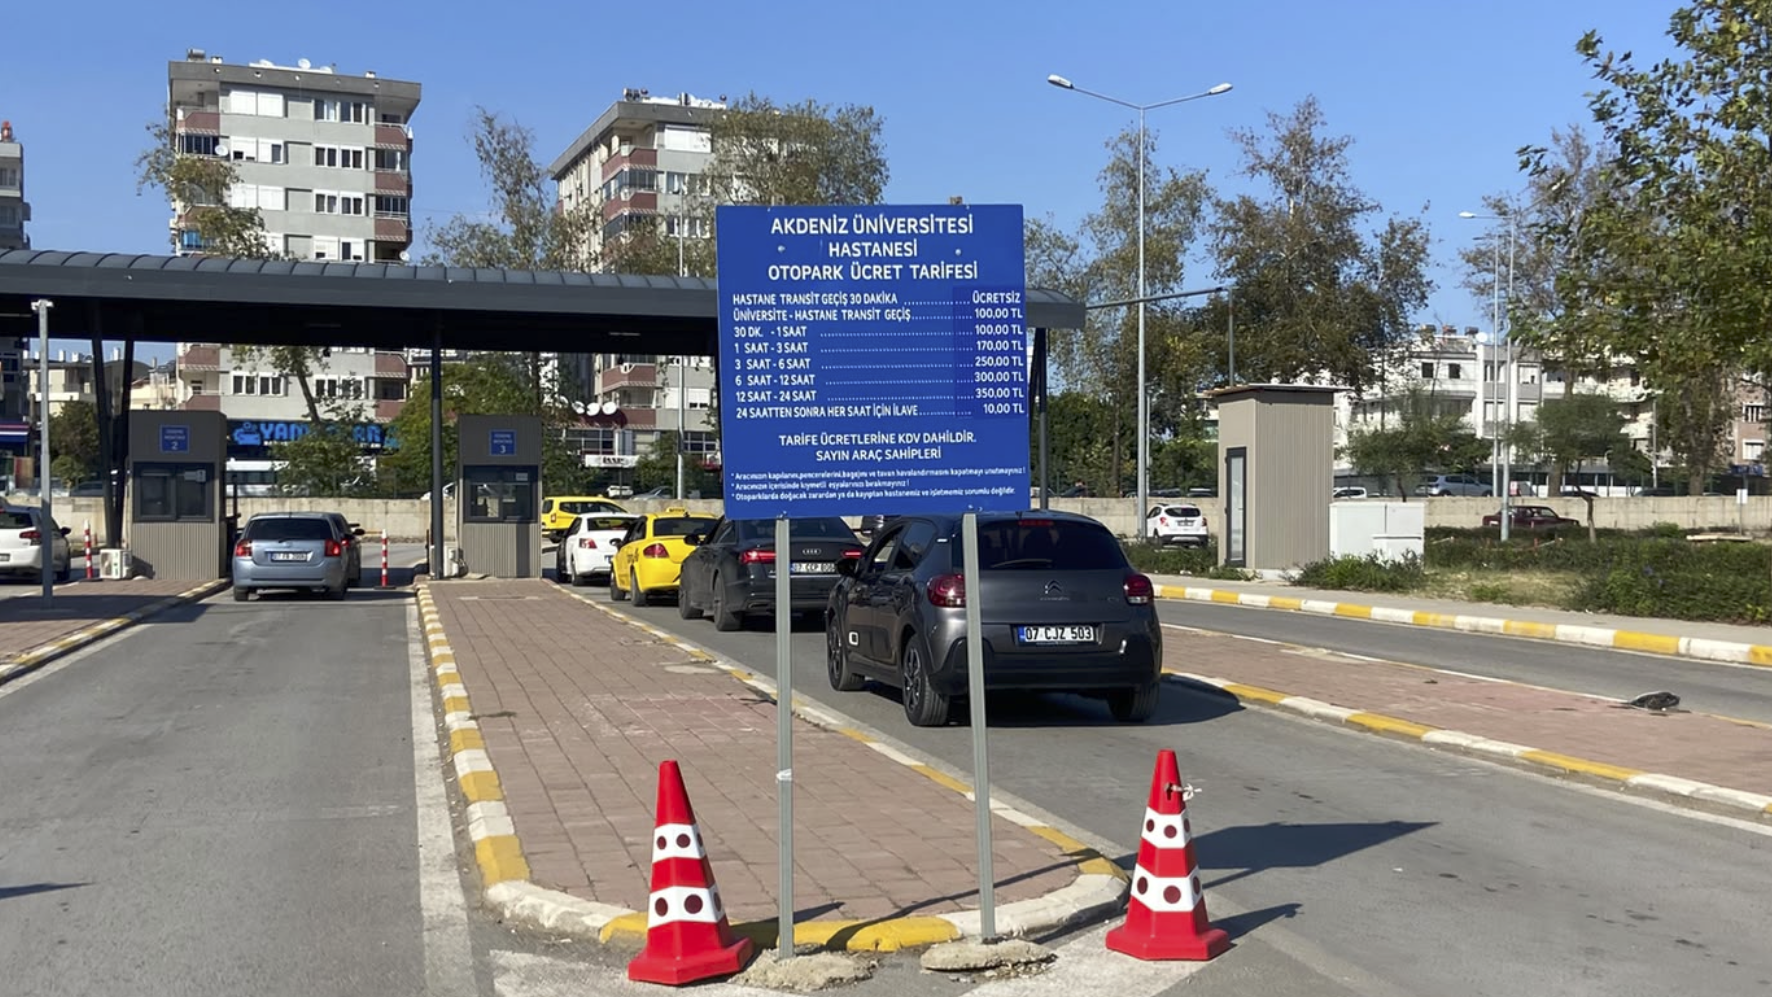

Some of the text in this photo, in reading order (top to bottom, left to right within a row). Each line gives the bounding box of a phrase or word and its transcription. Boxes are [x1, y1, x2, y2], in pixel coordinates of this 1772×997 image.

[771, 214, 973, 234] AKDENİZ ÜNİVERSİTESİ
[829, 238, 917, 257] HASTANESİ
[768, 261, 977, 280] OTOPARK ÜCRET TARİFESİ
[733, 290, 1020, 306] HASTANE TRANSİT GEÇİŞ 30 DAKİKA ÜCRETSİZ
[734, 308, 787, 321] ÜNİVERSİTE
[795, 310, 837, 320] HASTANE
[841, 307, 881, 320] TRANSİT
[884, 307, 911, 322] GEÇİŞ
[975, 308, 1008, 319] 100,00
[1011, 308, 1022, 318] TL
[734, 326, 746, 337] 30
[783, 326, 807, 337] SAAT
[975, 324, 1009, 335] 100,00
[1011, 324, 1023, 334] TL
[744, 342, 769, 353] SAAT
[777, 342, 782, 353] 3
[784, 342, 808, 353] SAAT
[977, 340, 1009, 351] 170,00
[1011, 340, 1023, 350] TL
[735, 359, 741, 370] 3
[747, 359, 771, 370] SAAT
[778, 359, 785, 369] 6
[787, 358, 810, 369] SAAT
[975, 355, 1009, 367] 250,00
[1012, 355, 1023, 366] TL
[735, 375, 742, 386] 6
[748, 375, 772, 386] SAAT
[780, 375, 789, 385] 12
[791, 374, 815, 385] SAAT
[975, 371, 1009, 383] 300,00
[1012, 371, 1024, 382] TL
[736, 391, 746, 402] 12
[747, 391, 772, 402] SAAT
[779, 391, 790, 401] 24
[792, 390, 816, 401] SAAT
[976, 387, 1010, 399] 350,00
[1012, 387, 1024, 398] TL
[737, 403, 1024, 418] 24 SAATTEN SONRA HER SAAT İÇİN İLAVE 10,00 TL
[779, 430, 976, 445] TARİFE ÜCRETLERİNE KDV DAHİLDİR.
[171, 441, 178, 450] 2
[499, 445, 506, 454] 3
[816, 446, 941, 462] SAYIN ARAÇ SAHİPLERİ
[1026, 625, 1092, 640] 07 CJZ 503
